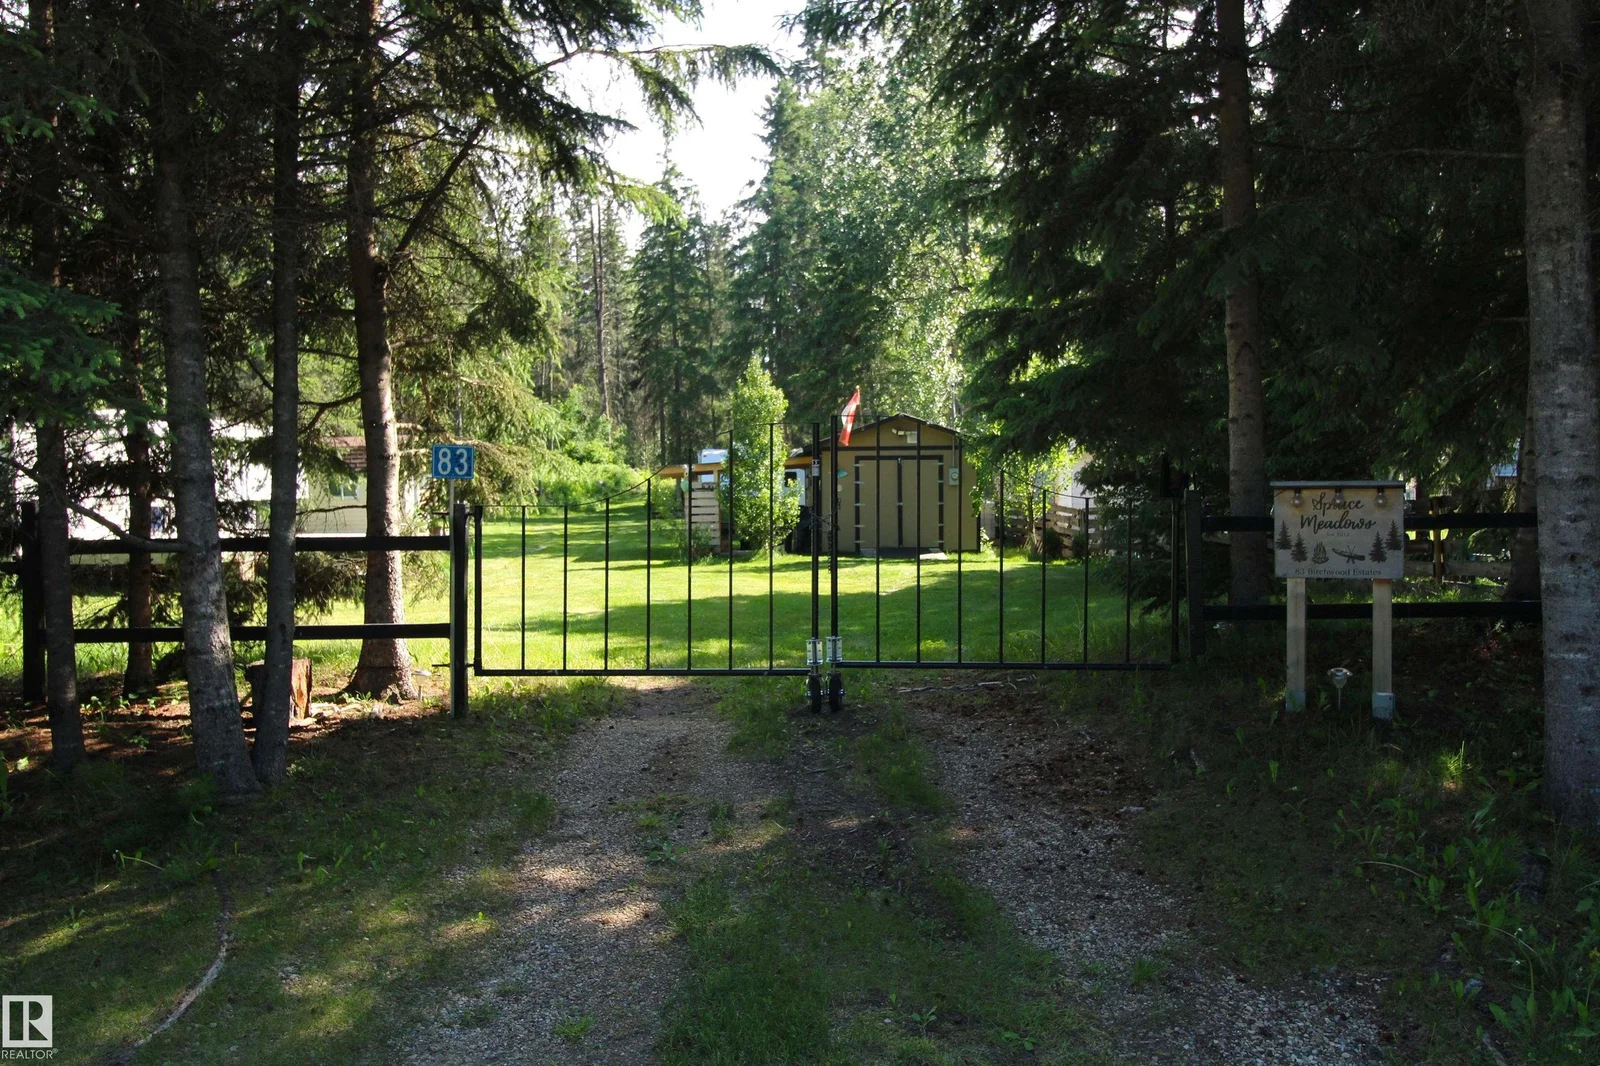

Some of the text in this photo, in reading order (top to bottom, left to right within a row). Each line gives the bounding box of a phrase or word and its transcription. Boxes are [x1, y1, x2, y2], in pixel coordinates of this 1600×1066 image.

[438, 447, 468, 475] 83
[1300, 511, 1376, 534] Meadows
[1307, 568, 1351, 576] Birchwood
[1352, 568, 1382, 576] Estates
